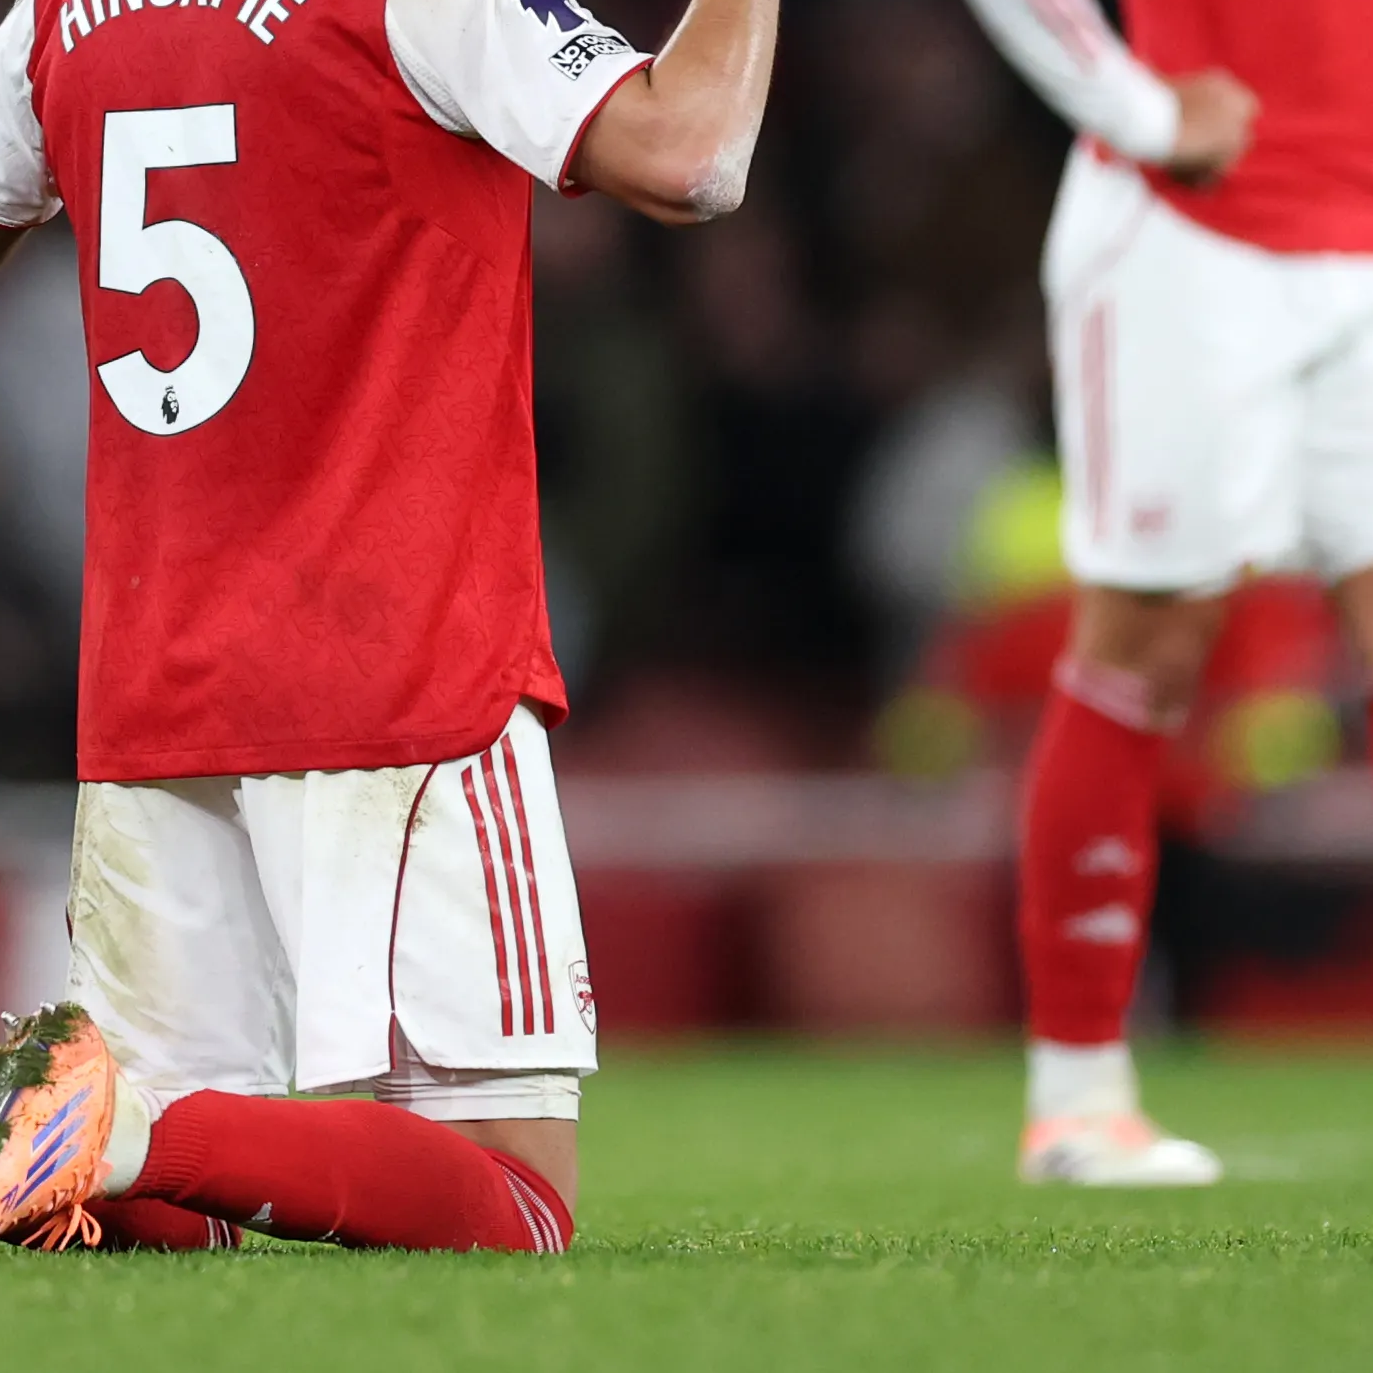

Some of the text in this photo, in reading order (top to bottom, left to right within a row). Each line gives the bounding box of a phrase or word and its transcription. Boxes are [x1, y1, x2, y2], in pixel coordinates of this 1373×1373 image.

[549, 45, 581, 71] No
[563, 51, 592, 81] for
[96, 103, 257, 437] 5
